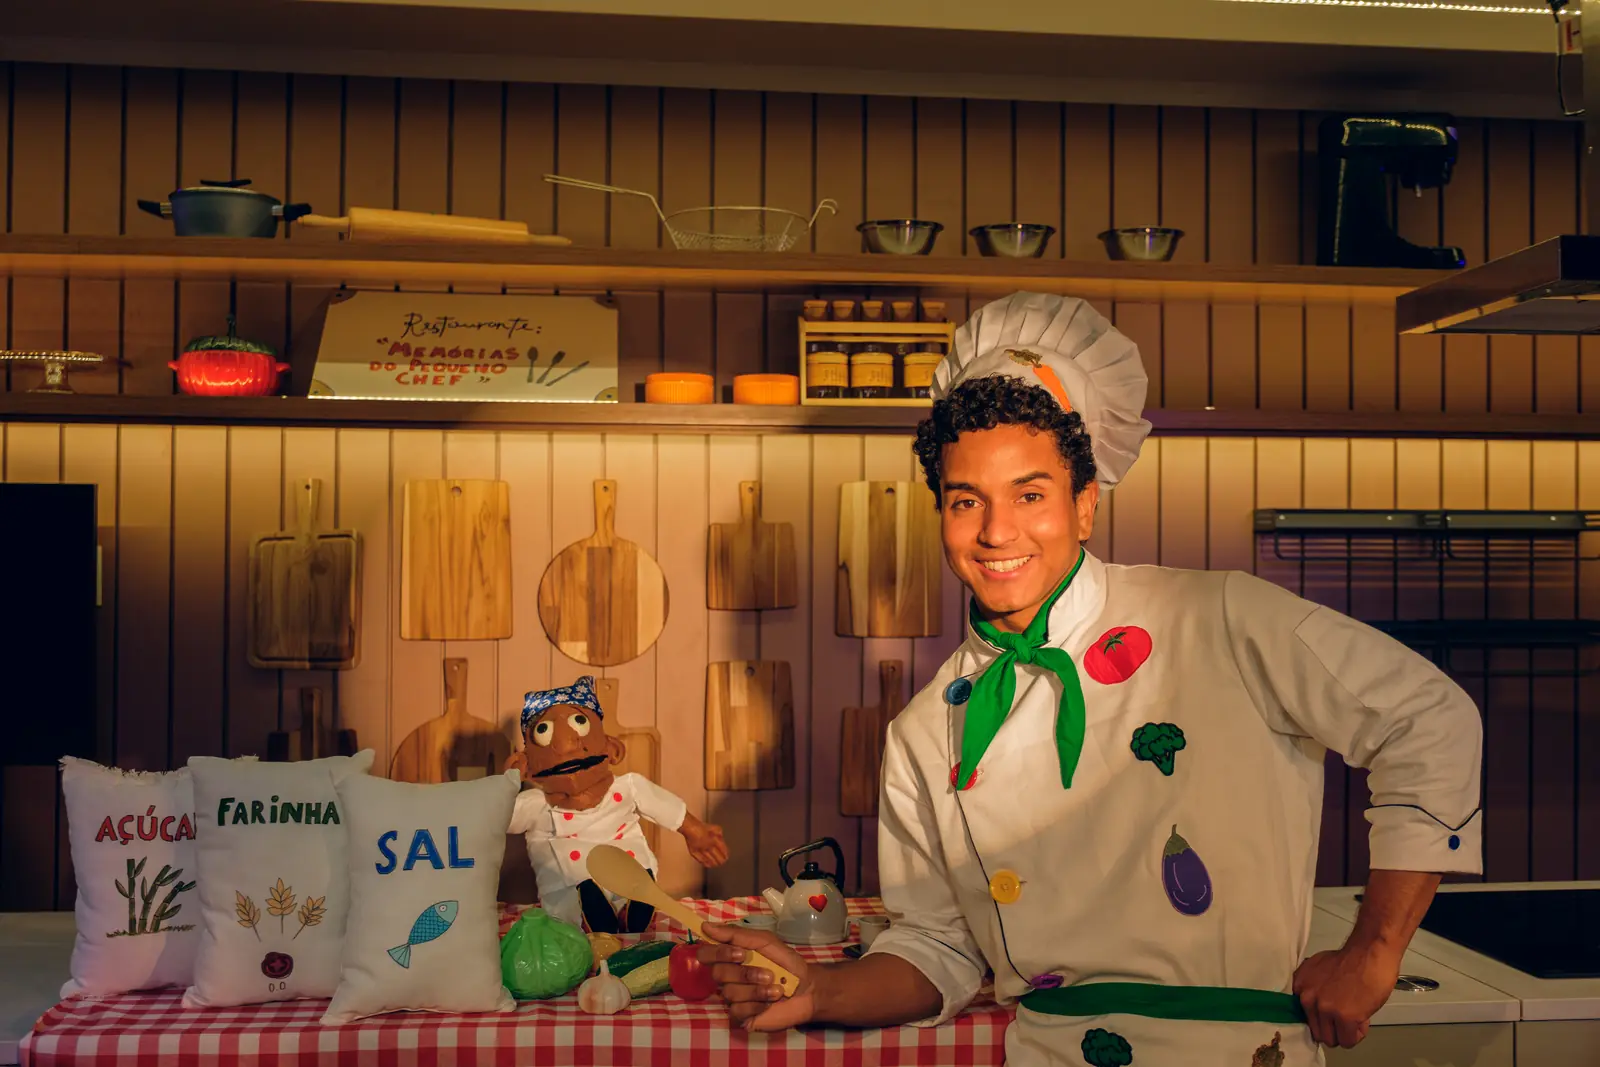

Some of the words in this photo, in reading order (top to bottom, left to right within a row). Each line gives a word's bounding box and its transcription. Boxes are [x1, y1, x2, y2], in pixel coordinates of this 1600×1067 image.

[369, 360, 397, 372] DO
[409, 358, 508, 375] PEQUENO
[95, 804, 197, 845] AÇÚCA
[375, 826, 475, 875] SAL
